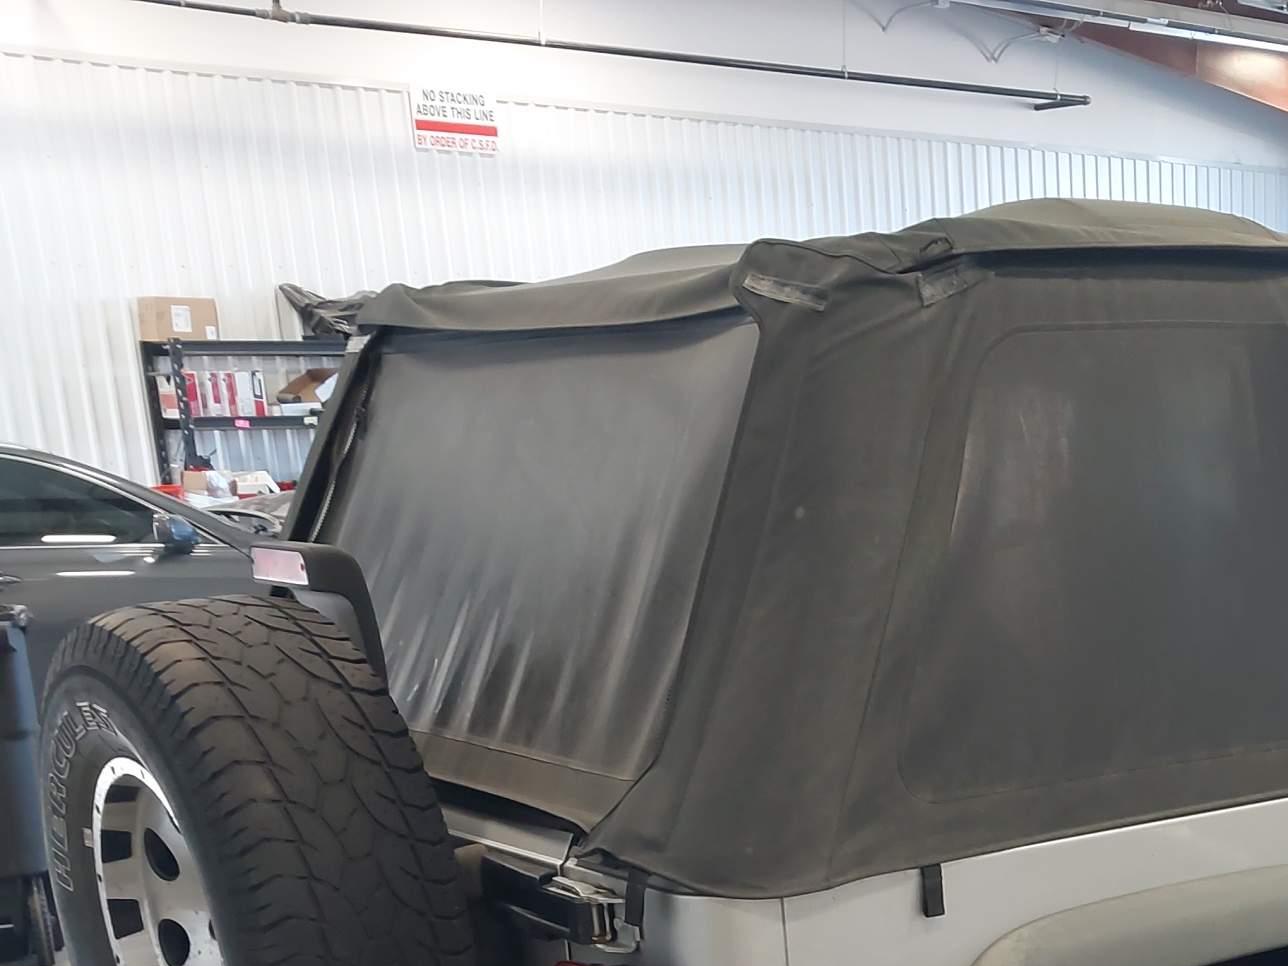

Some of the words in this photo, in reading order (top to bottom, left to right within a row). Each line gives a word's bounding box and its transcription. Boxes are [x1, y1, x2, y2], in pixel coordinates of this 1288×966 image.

[422, 89, 436, 102] NO
[439, 90, 485, 106] STACKING
[416, 104, 448, 118] ABOVE
[450, 106, 472, 120] THIS
[473, 109, 495, 122] LINE
[416, 134, 427, 145] BY
[430, 135, 457, 148] ORDER
[459, 137, 470, 149] OF
[48, 701, 118, 892] HERCULES
